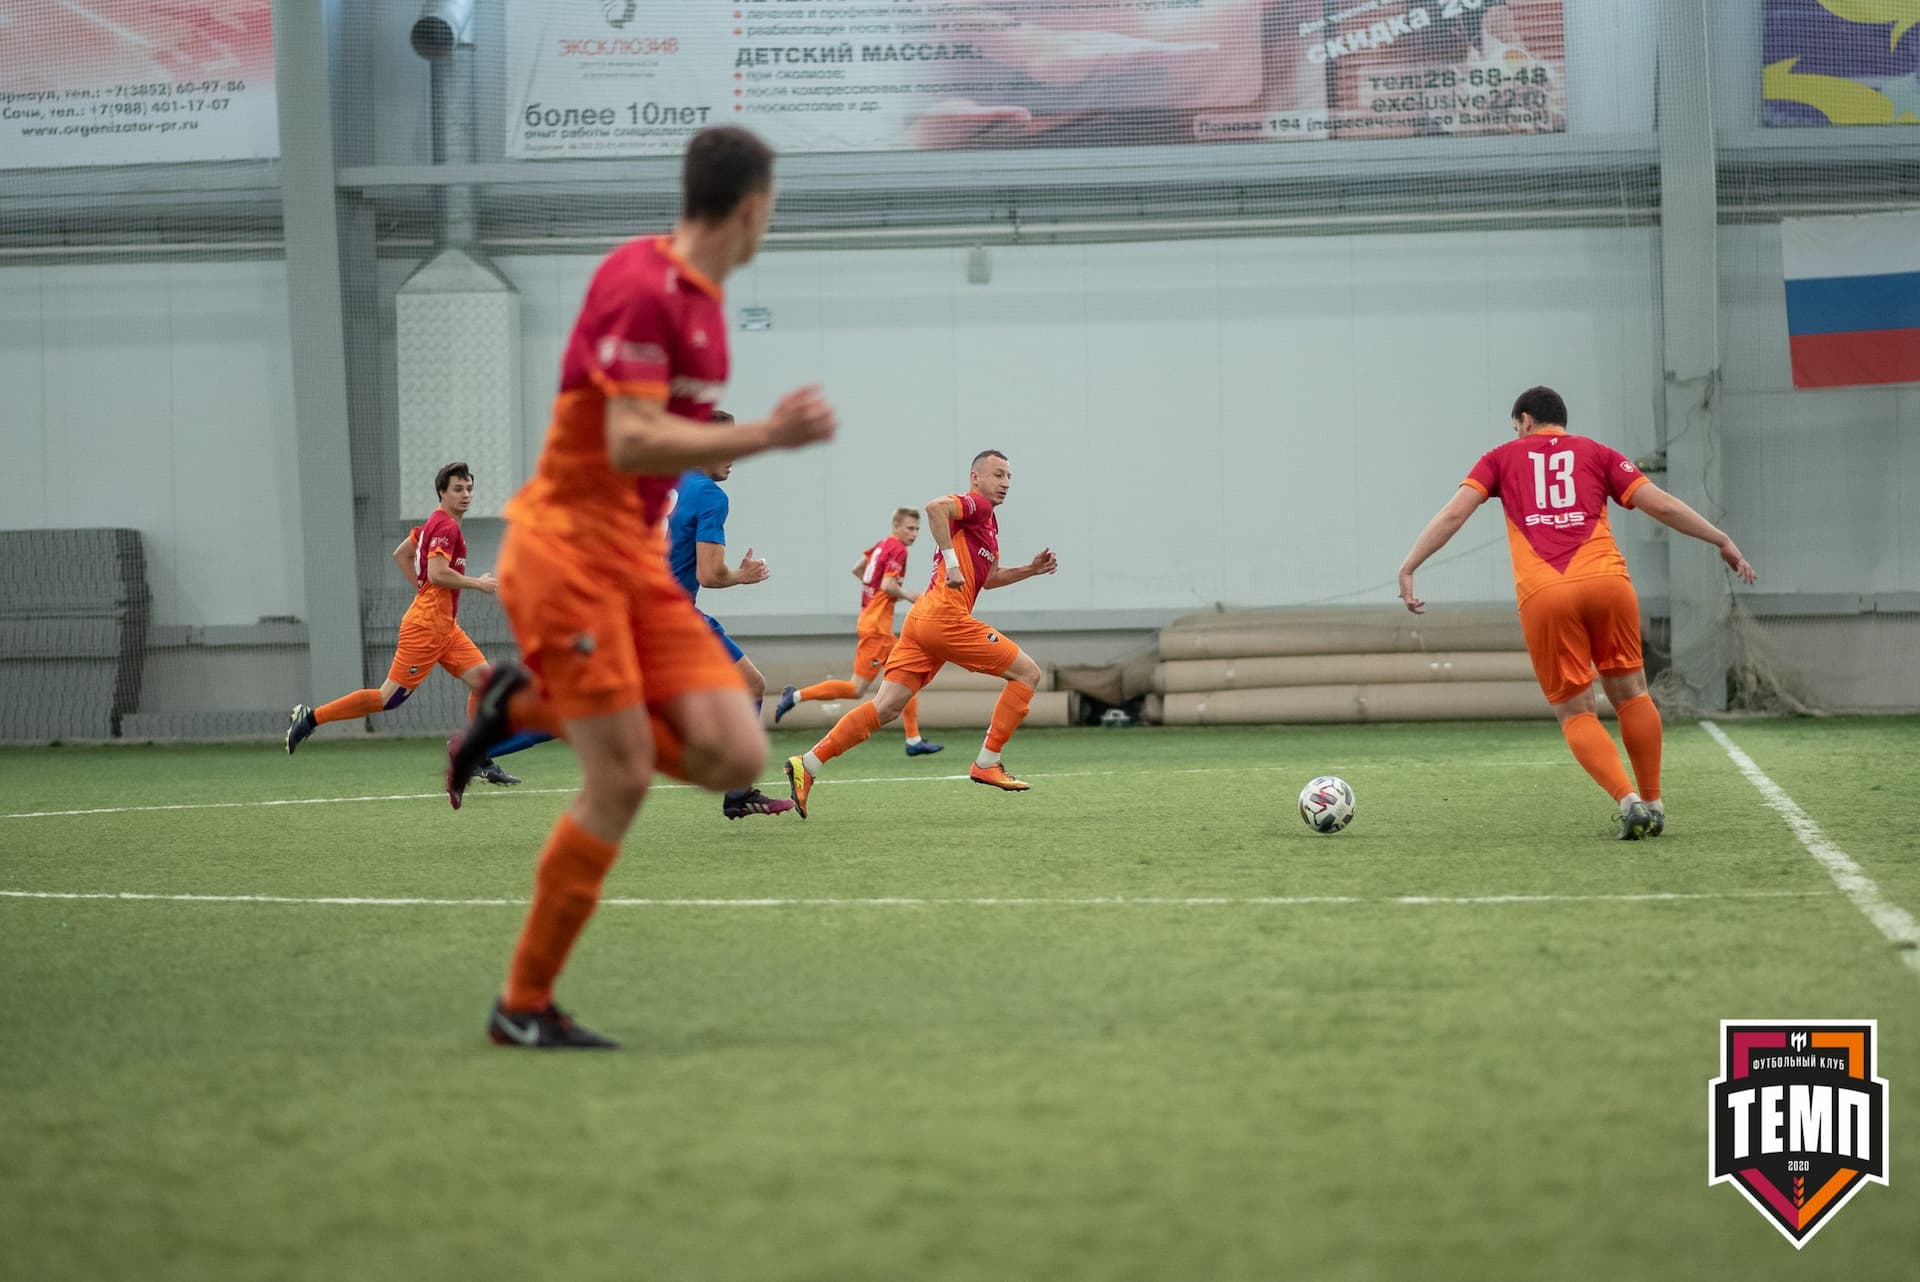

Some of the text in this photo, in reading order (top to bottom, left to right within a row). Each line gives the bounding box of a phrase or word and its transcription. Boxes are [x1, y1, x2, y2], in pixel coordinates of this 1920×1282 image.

[559, 37, 679, 57] ЭКСКЛЮЗИВ
[1308, 7, 1431, 64] скидка
[735, 43, 983, 68] ДЕТСКИЙ МАССАЖ:
[525, 102, 711, 127] более 10лет
[613, 126, 700, 138] специалисто
[1528, 450, 1577, 509] 13
[1525, 511, 1586, 526] SEUS
